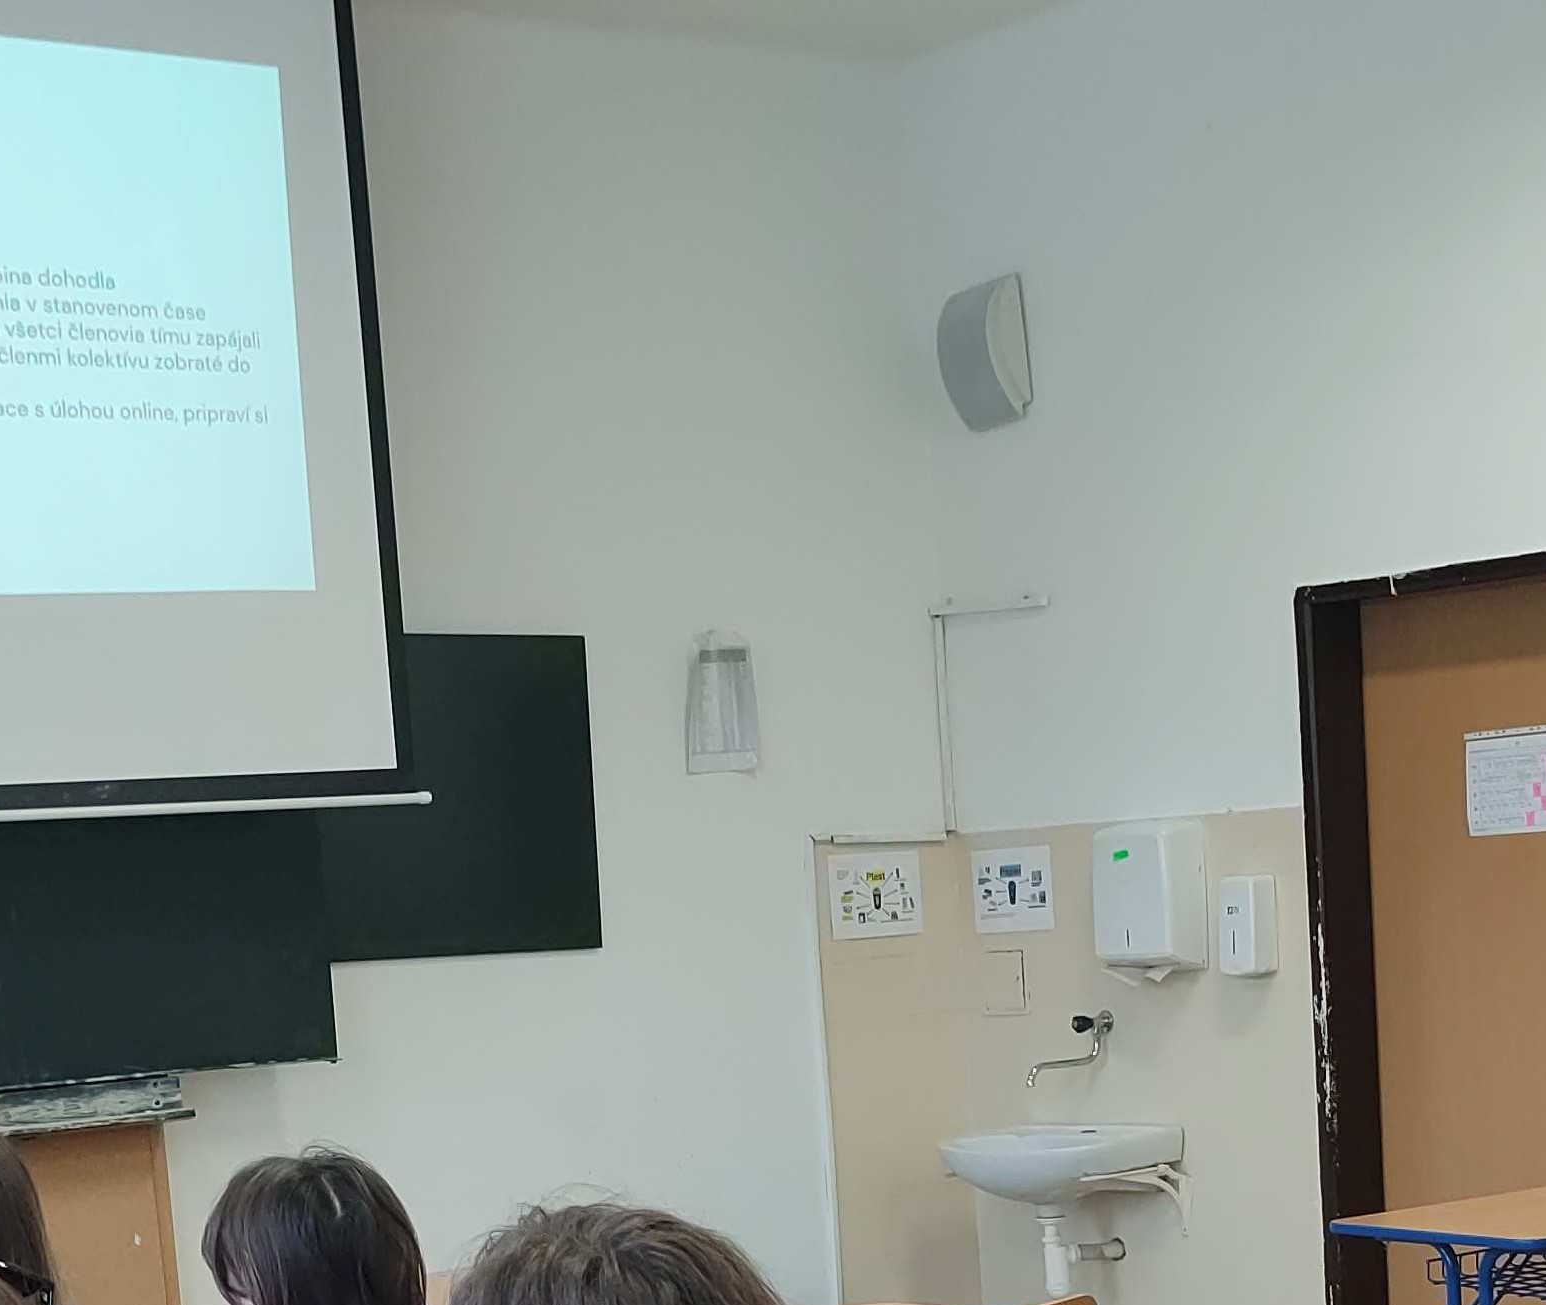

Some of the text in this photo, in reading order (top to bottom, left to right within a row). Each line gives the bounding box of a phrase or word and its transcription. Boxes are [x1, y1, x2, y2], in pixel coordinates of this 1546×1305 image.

[38, 266, 116, 290] dohodla
[26, 301, 38, 313] v
[43, 299, 158, 319] stanovenom
[163, 303, 206, 321] čase
[5, 319, 62, 340] všetci
[68, 322, 145, 344] členovia
[67, 348, 150, 372] kolektívu
[228, 355, 251, 375] do
[34, 404, 45, 419] s
[120, 402, 179, 423] online,
[254, 405, 269, 424] si
